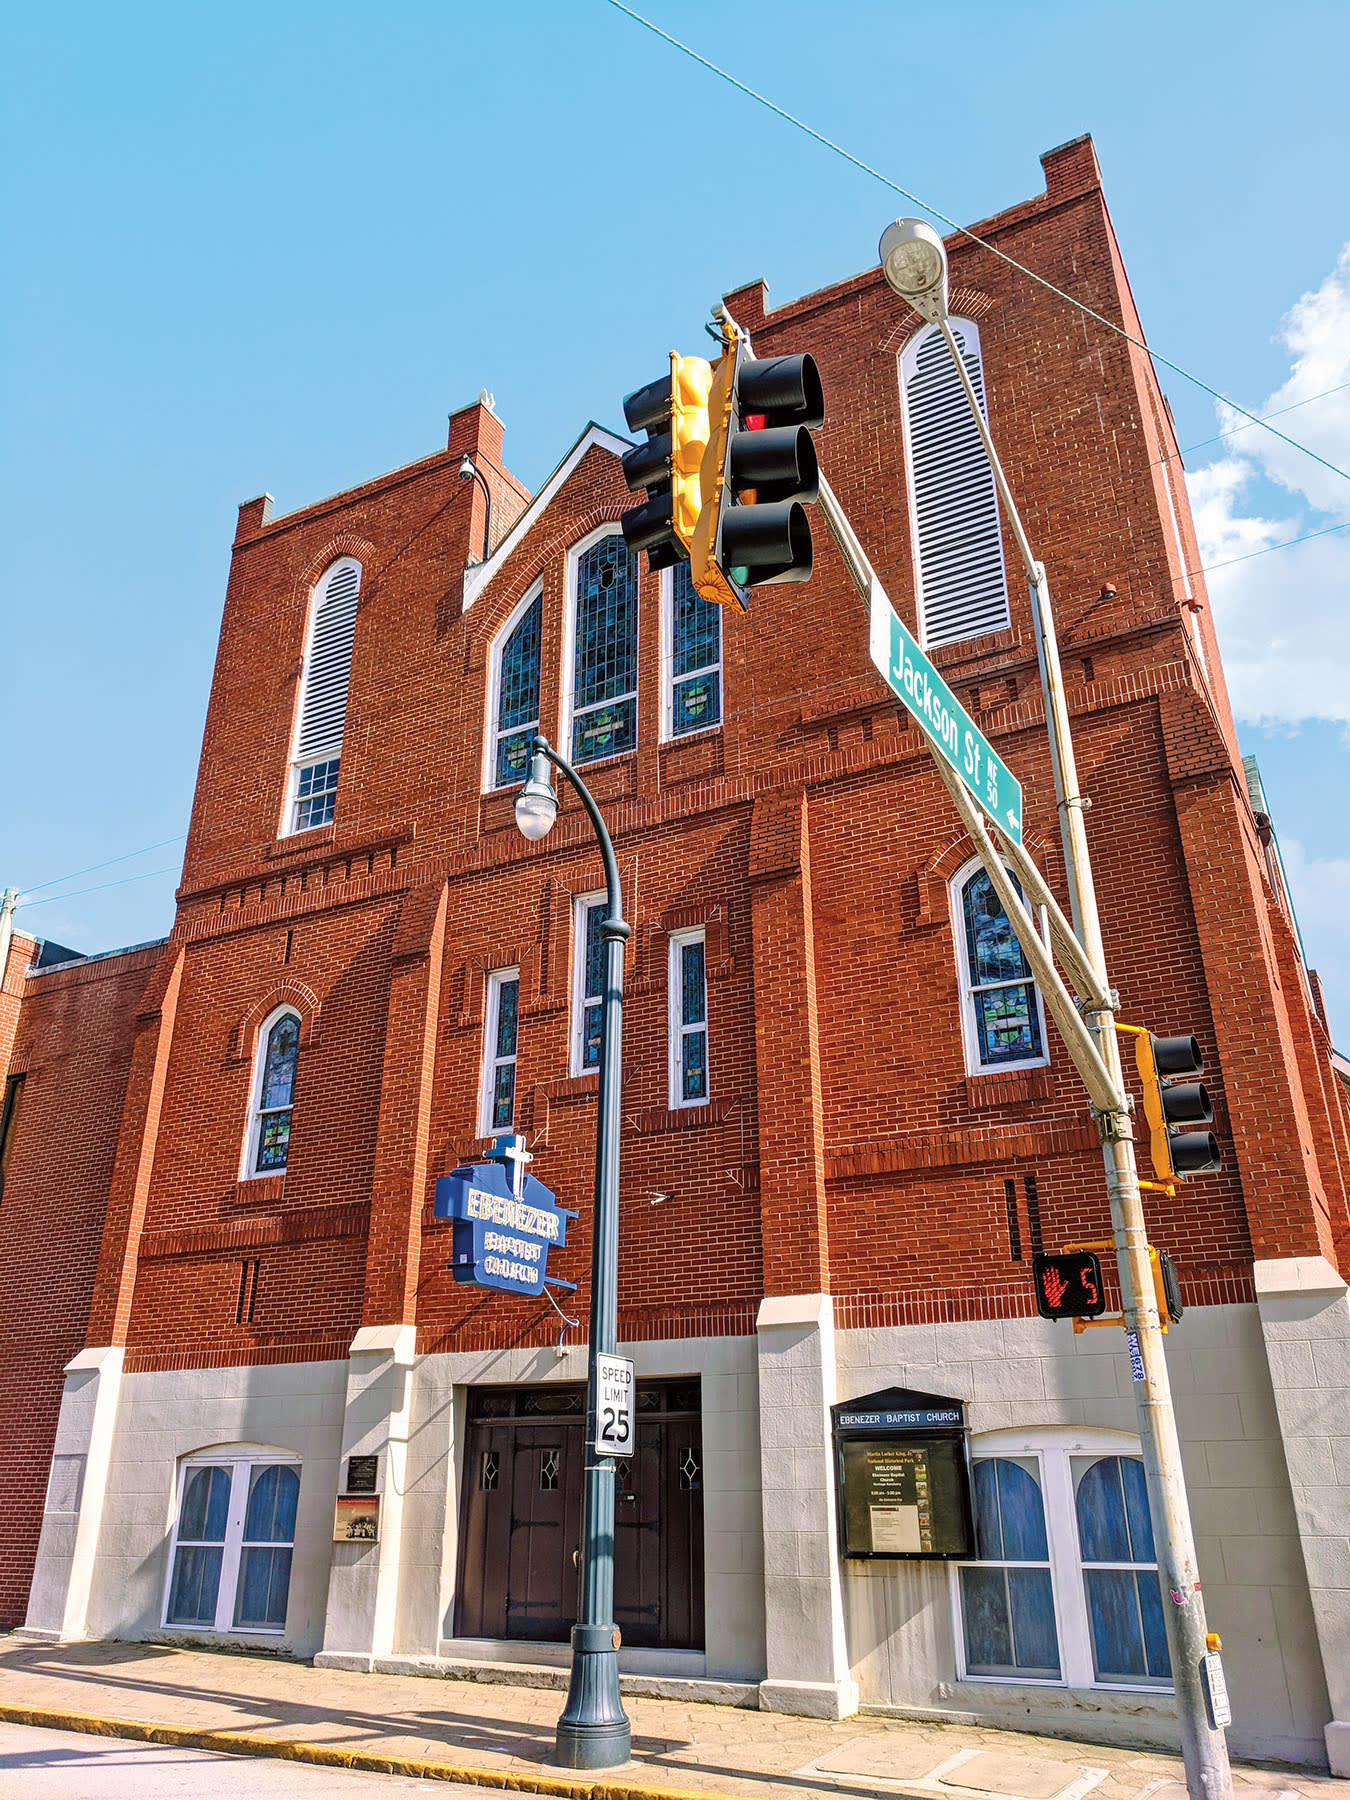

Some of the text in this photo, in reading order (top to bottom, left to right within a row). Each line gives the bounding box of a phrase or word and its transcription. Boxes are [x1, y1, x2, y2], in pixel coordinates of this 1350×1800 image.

[893, 637, 981, 786] Jackson St
[987, 756, 998, 787] NE
[987, 780, 998, 809] 50
[468, 1188, 560, 1240] EBENEZER
[484, 1232, 543, 1262] BAPTIST
[484, 1256, 538, 1283] CHURCH
[1080, 1267, 1098, 1304] 5
[602, 1366, 631, 1384] SPEED
[605, 1386, 628, 1403] LIMIT
[602, 1407, 629, 1443] 25
[840, 1412, 960, 1424] EBENEZER BAPTIST CHURCH
